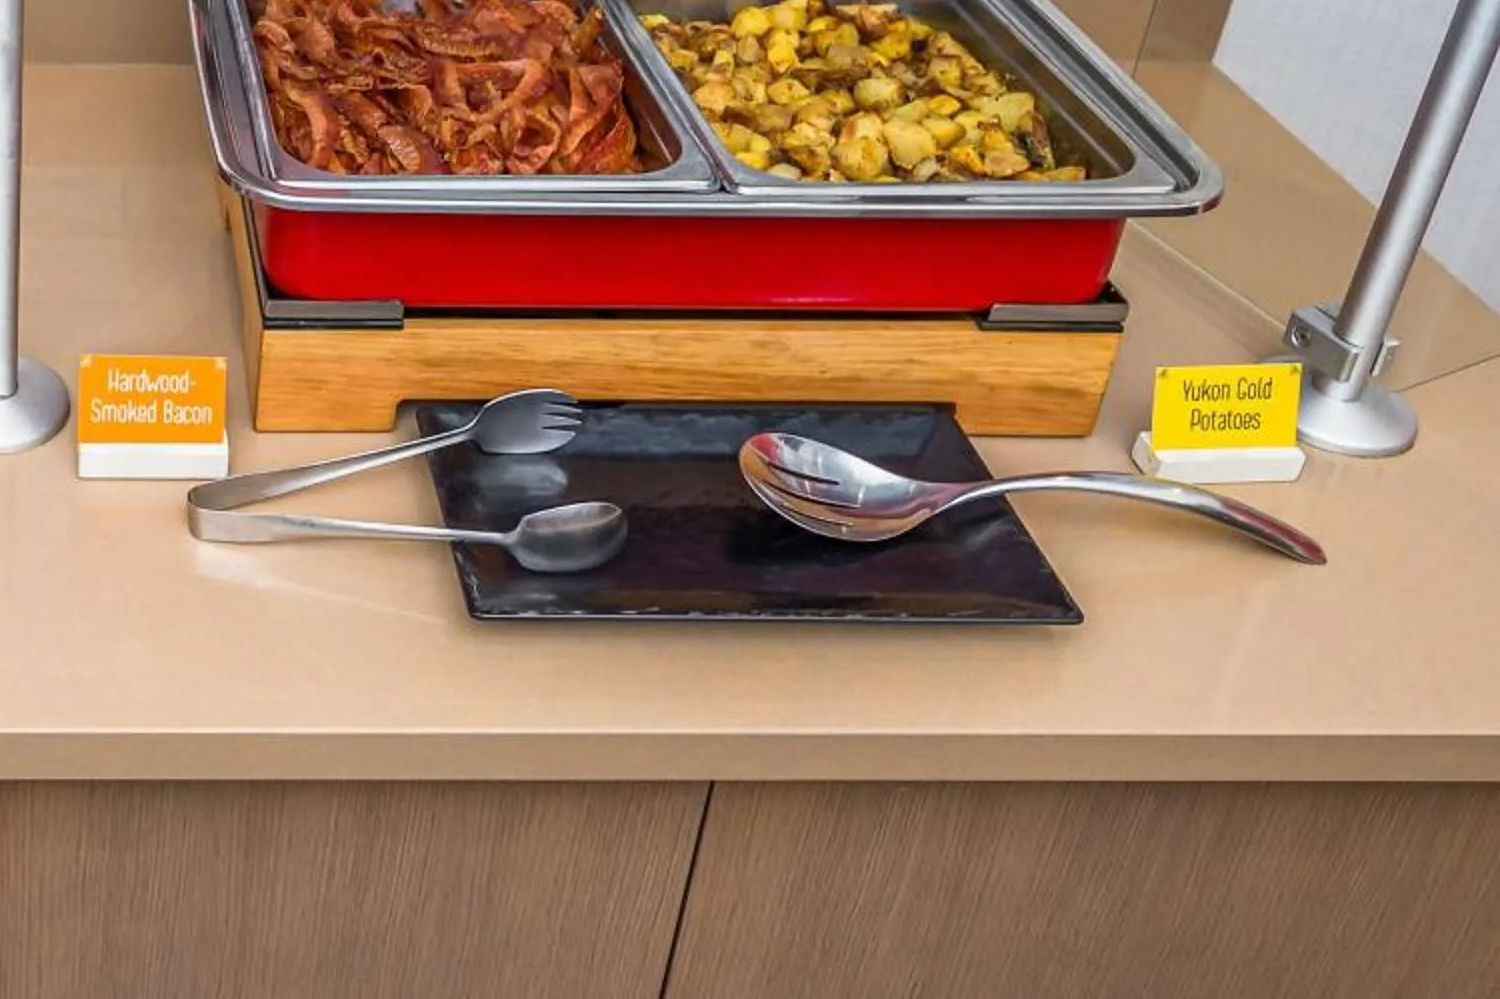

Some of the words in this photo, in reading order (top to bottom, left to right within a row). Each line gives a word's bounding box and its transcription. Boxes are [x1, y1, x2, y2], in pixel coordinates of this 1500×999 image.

[106, 367, 197, 394] Hardwood-
[1183, 378, 1231, 403] Yukon
[1236, 376, 1273, 401] Gold
[90, 397, 158, 425] Smoked
[163, 398, 213, 426] Bacon
[1190, 407, 1262, 432] Potatoes
